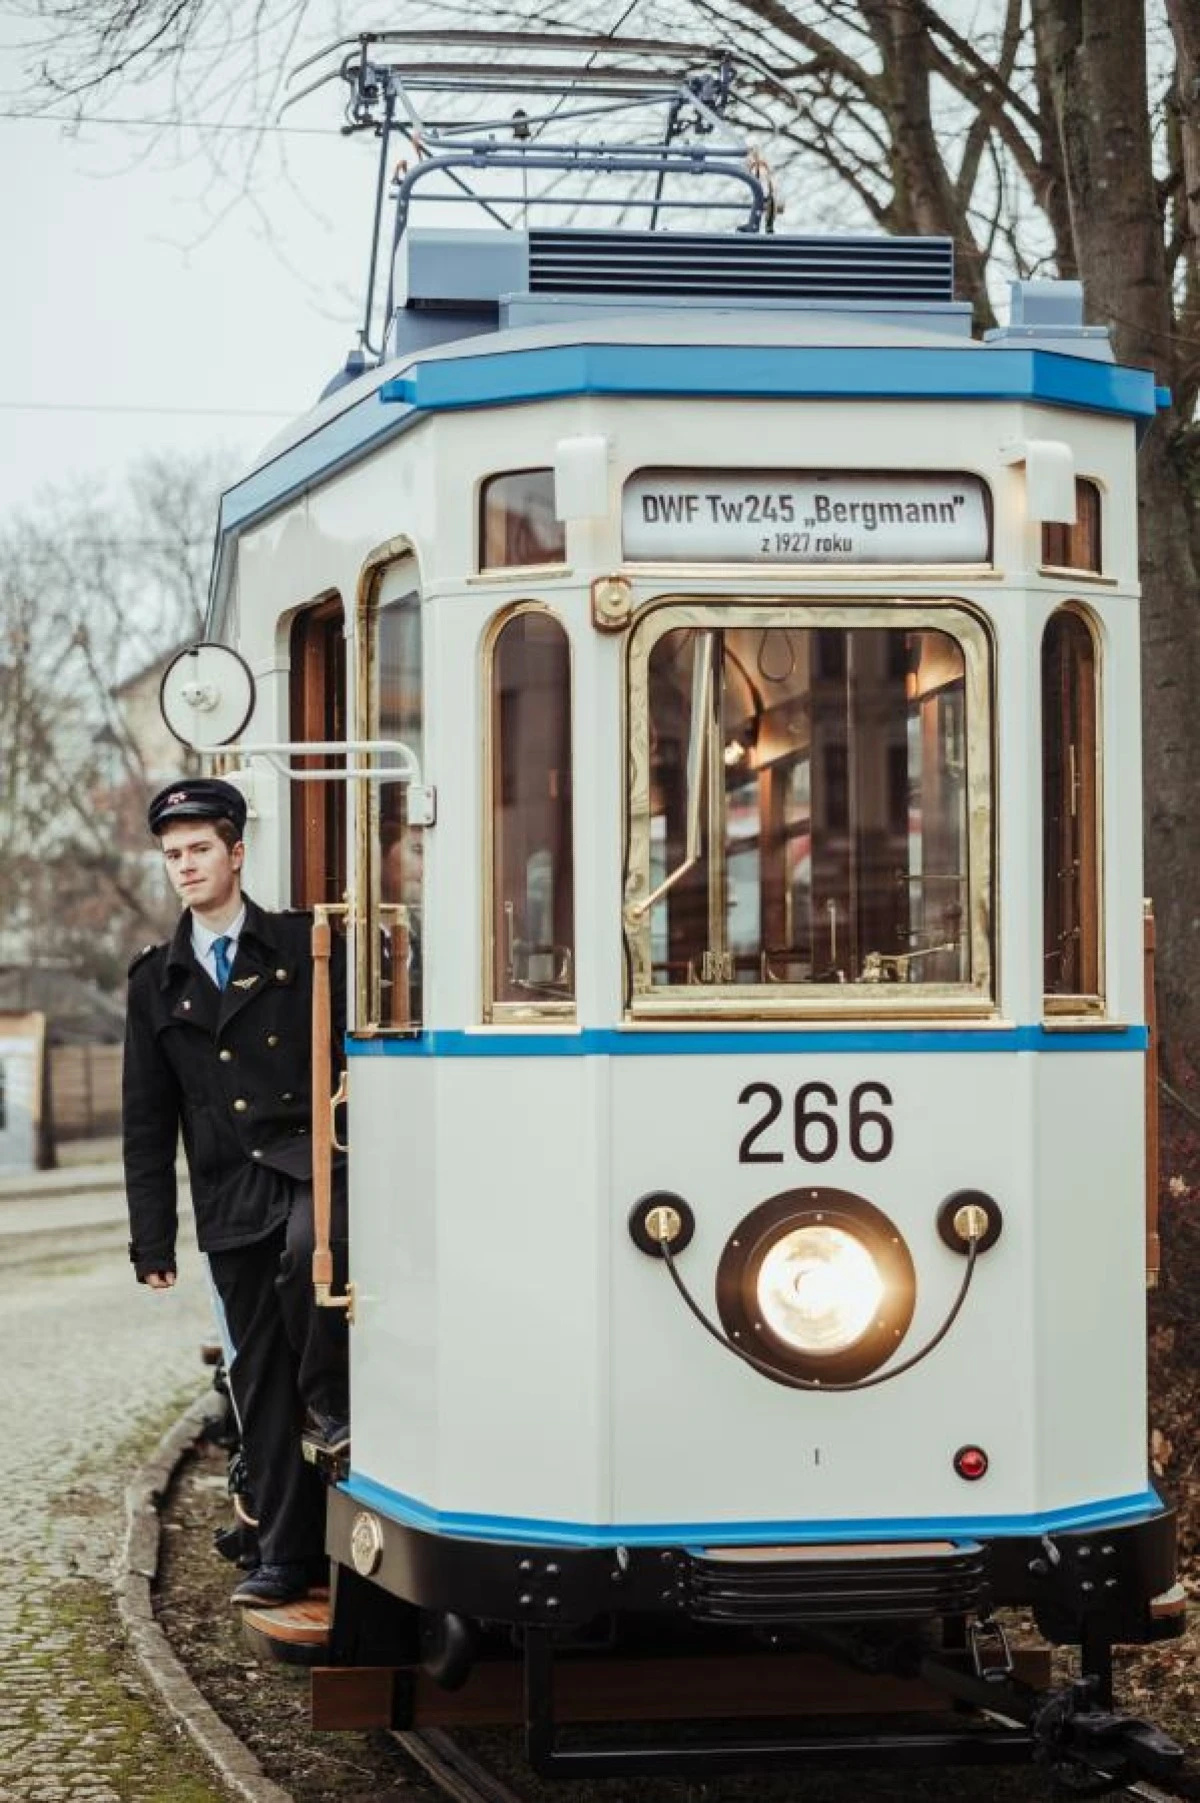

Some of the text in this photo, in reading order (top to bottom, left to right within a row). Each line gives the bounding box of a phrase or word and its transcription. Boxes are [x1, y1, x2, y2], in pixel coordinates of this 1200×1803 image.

[642, 494, 699, 523] DWF
[705, 494, 795, 523] Tw245
[761, 533, 853, 553] z 1927 roku
[737, 1081, 894, 1163] 266
